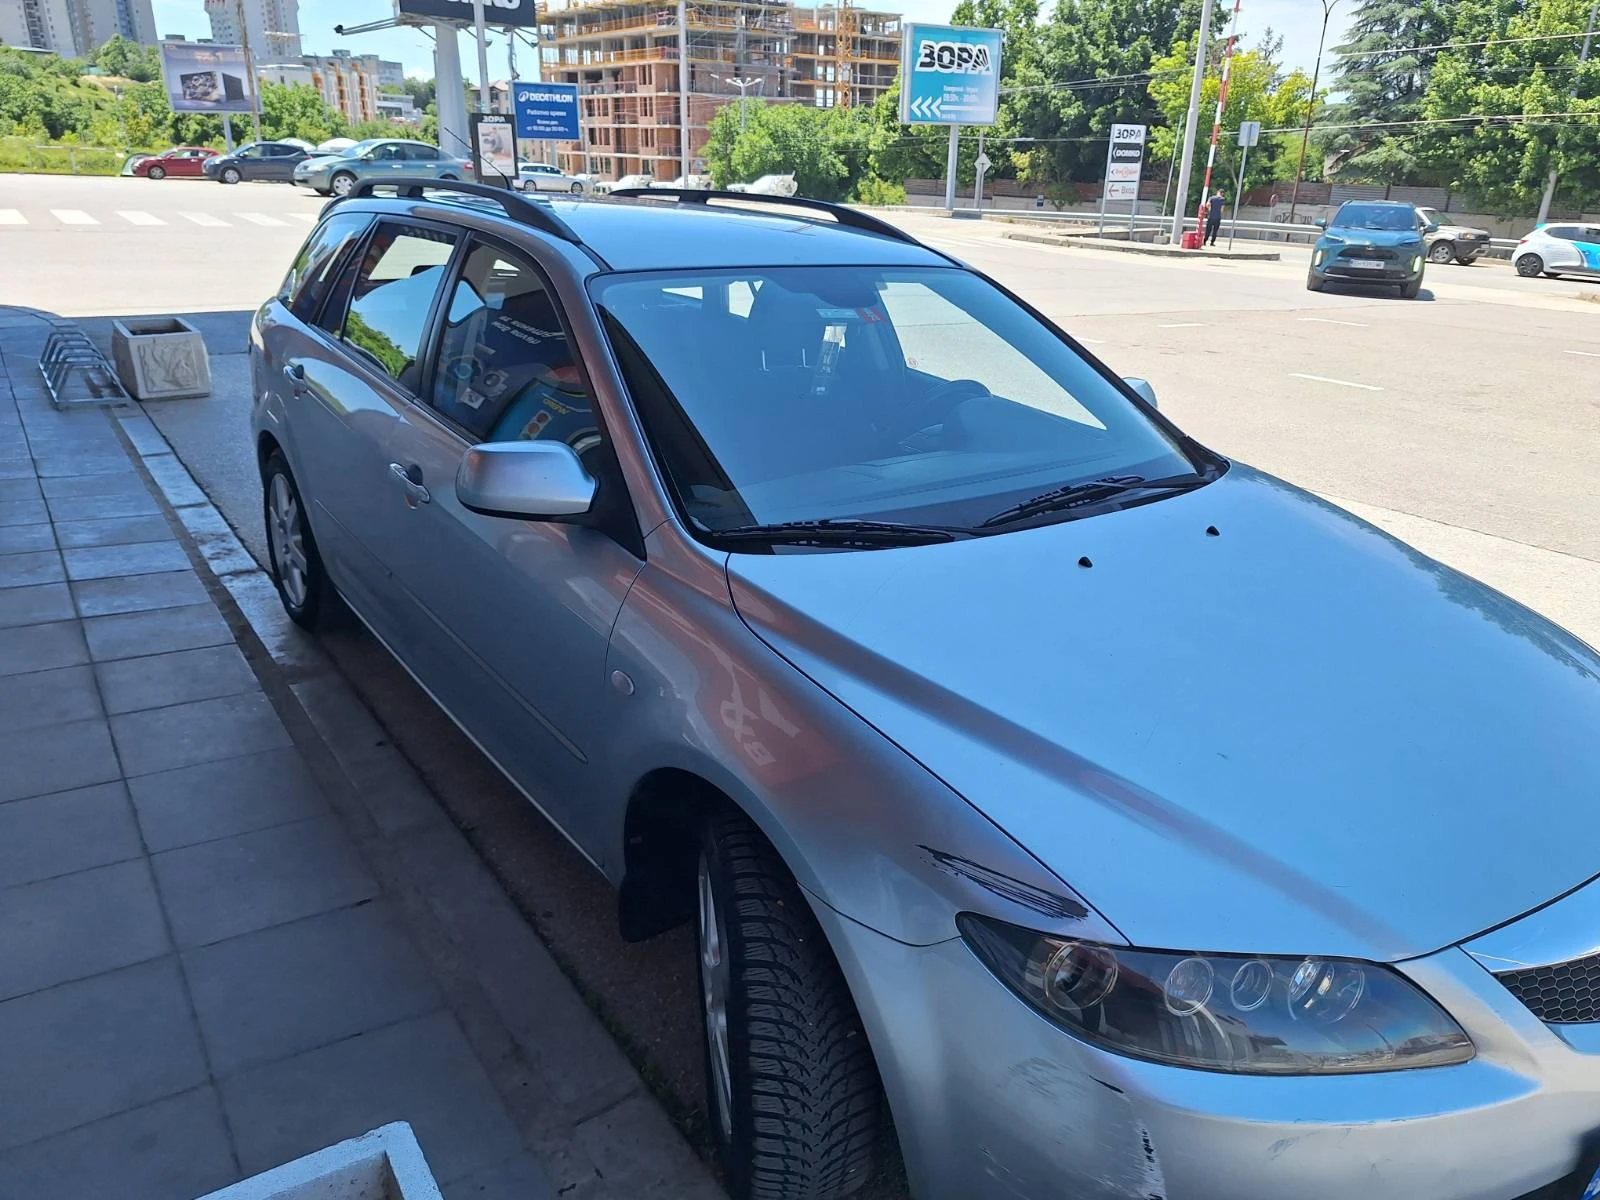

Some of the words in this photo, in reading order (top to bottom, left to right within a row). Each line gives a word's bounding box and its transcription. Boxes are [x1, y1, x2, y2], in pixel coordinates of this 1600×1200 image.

[917, 41, 992, 74] ЗОРА
[529, 92, 573, 103] DECATHLON
[482, 115, 506, 123] ЗОРА
[1115, 129, 1142, 139] ЗОРА
